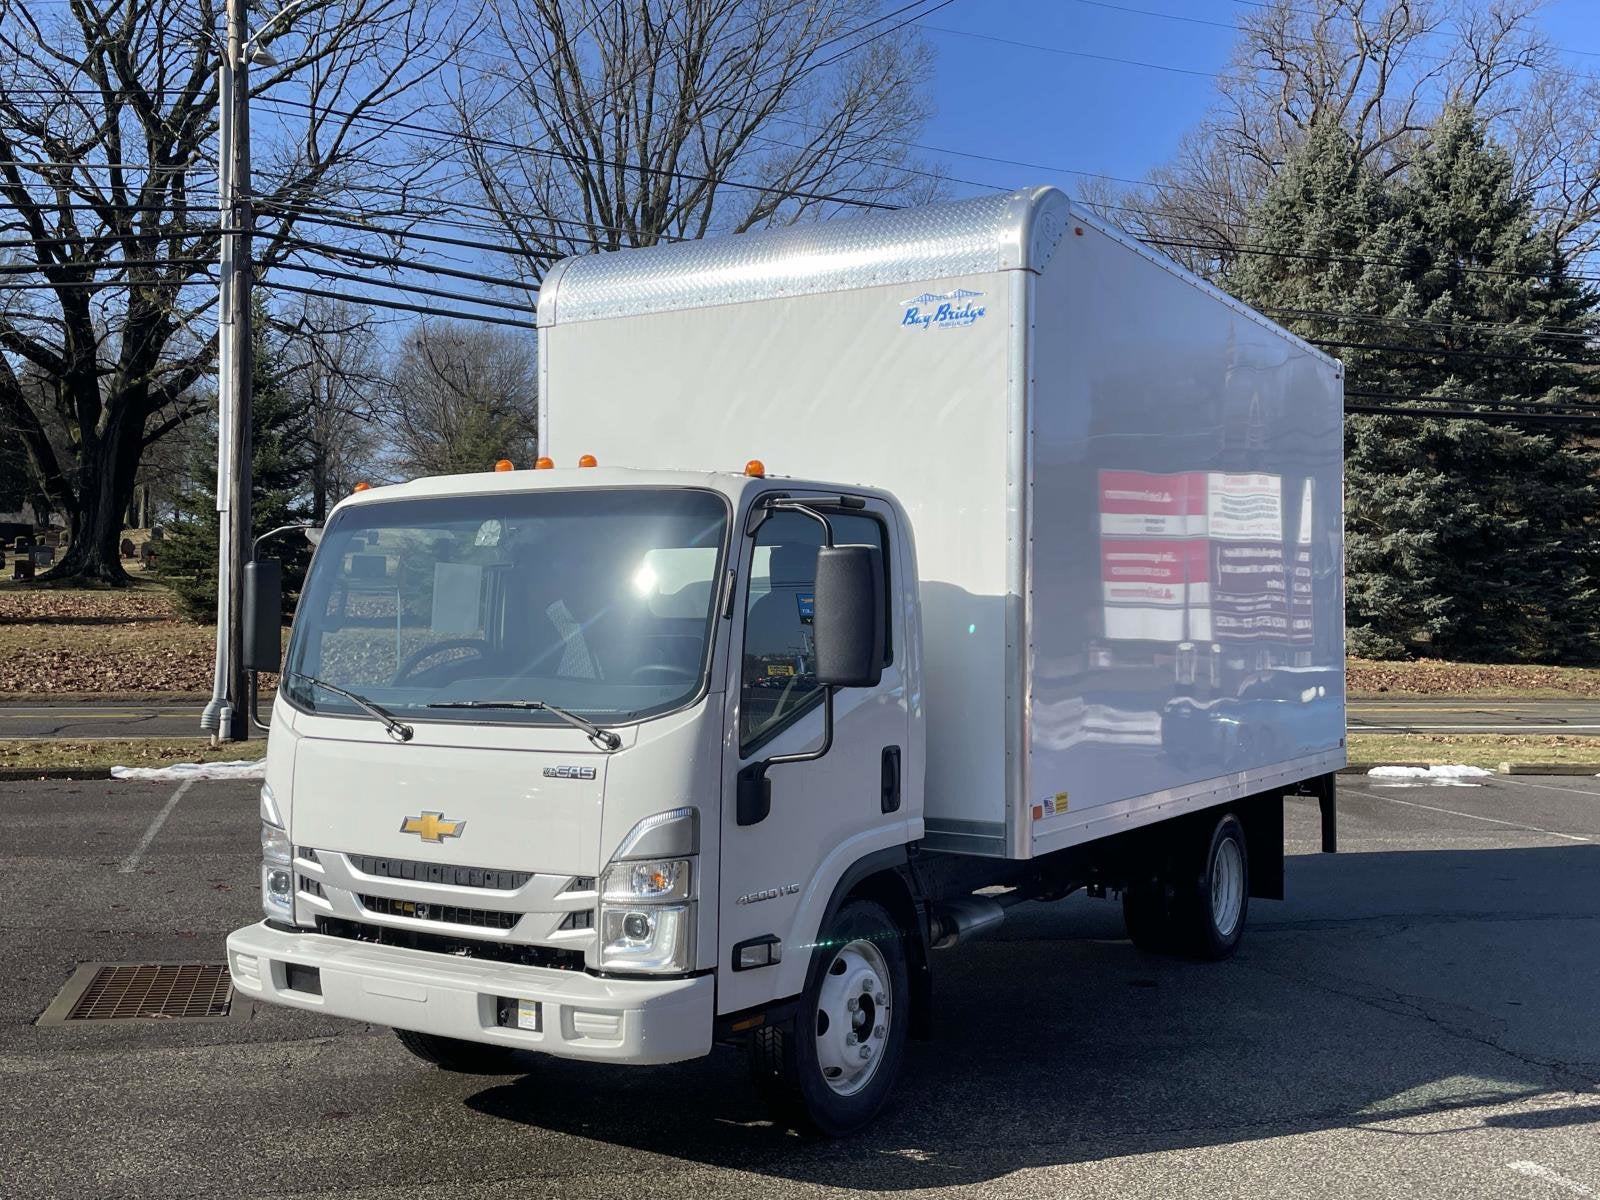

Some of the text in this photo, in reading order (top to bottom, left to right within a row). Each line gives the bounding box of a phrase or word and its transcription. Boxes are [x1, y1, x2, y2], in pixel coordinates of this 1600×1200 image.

[903, 307, 932, 329] Bay
[934, 303, 985, 323] Bridge
[556, 765, 596, 780] GAS
